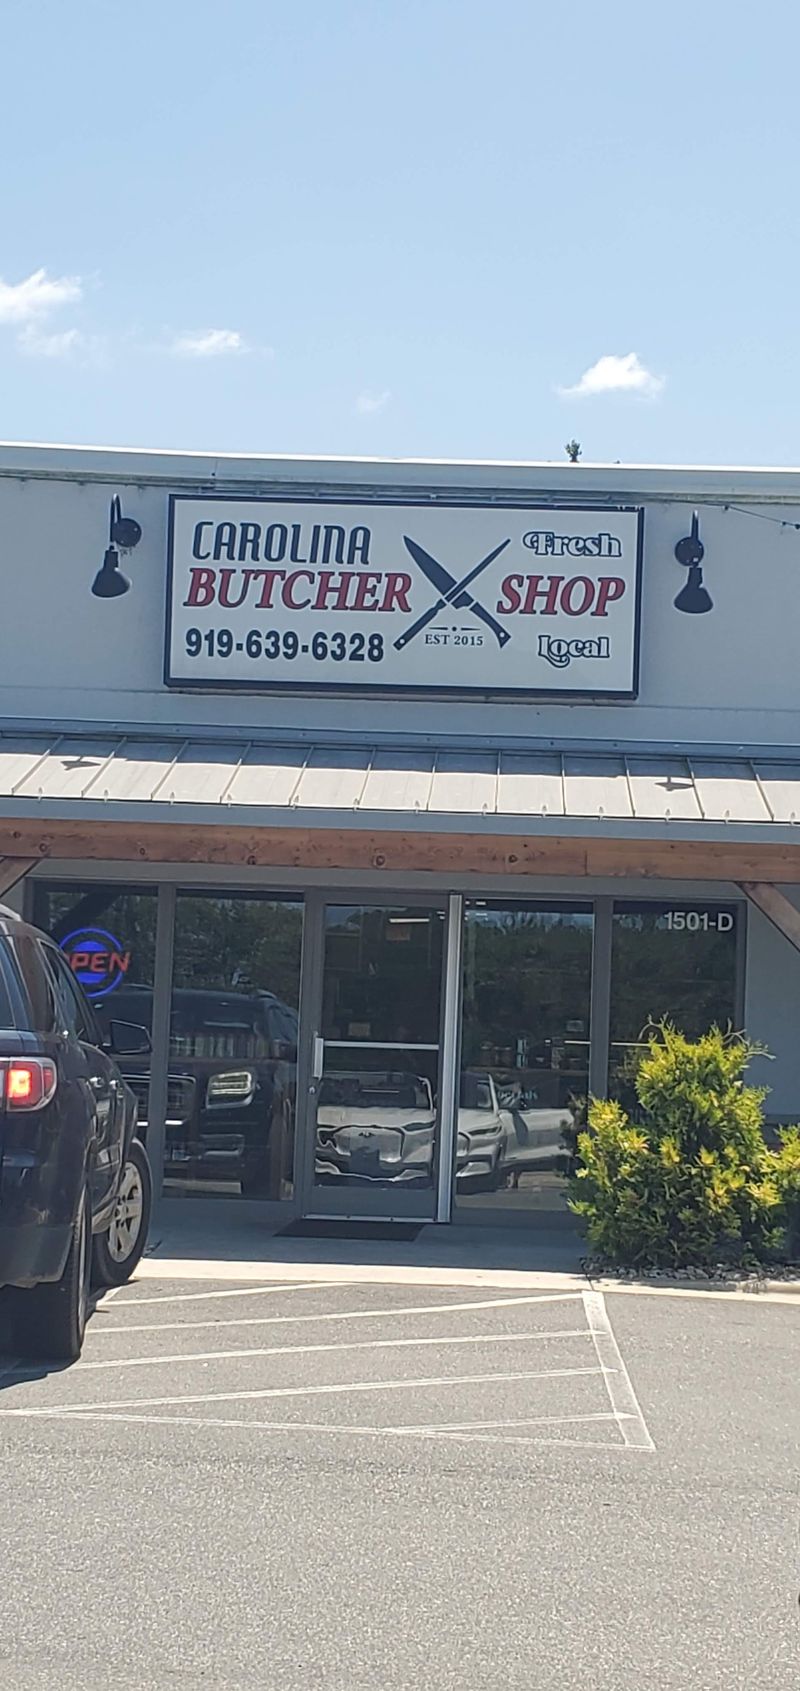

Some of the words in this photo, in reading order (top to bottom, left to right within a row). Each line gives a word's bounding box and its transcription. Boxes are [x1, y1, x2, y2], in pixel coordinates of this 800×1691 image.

[192, 521, 371, 565] CAROLINA
[522, 531, 622, 558] Fresh
[183, 568, 412, 613] BUTCHER
[496, 574, 626, 617] SHOP
[185, 628, 385, 663] 919-639-6328
[424, 633, 450, 645] EST
[453, 634, 484, 647] 2015
[538, 635, 610, 668] Local
[664, 911, 734, 932] 1501-D
[65, 951, 131, 973] PEN
